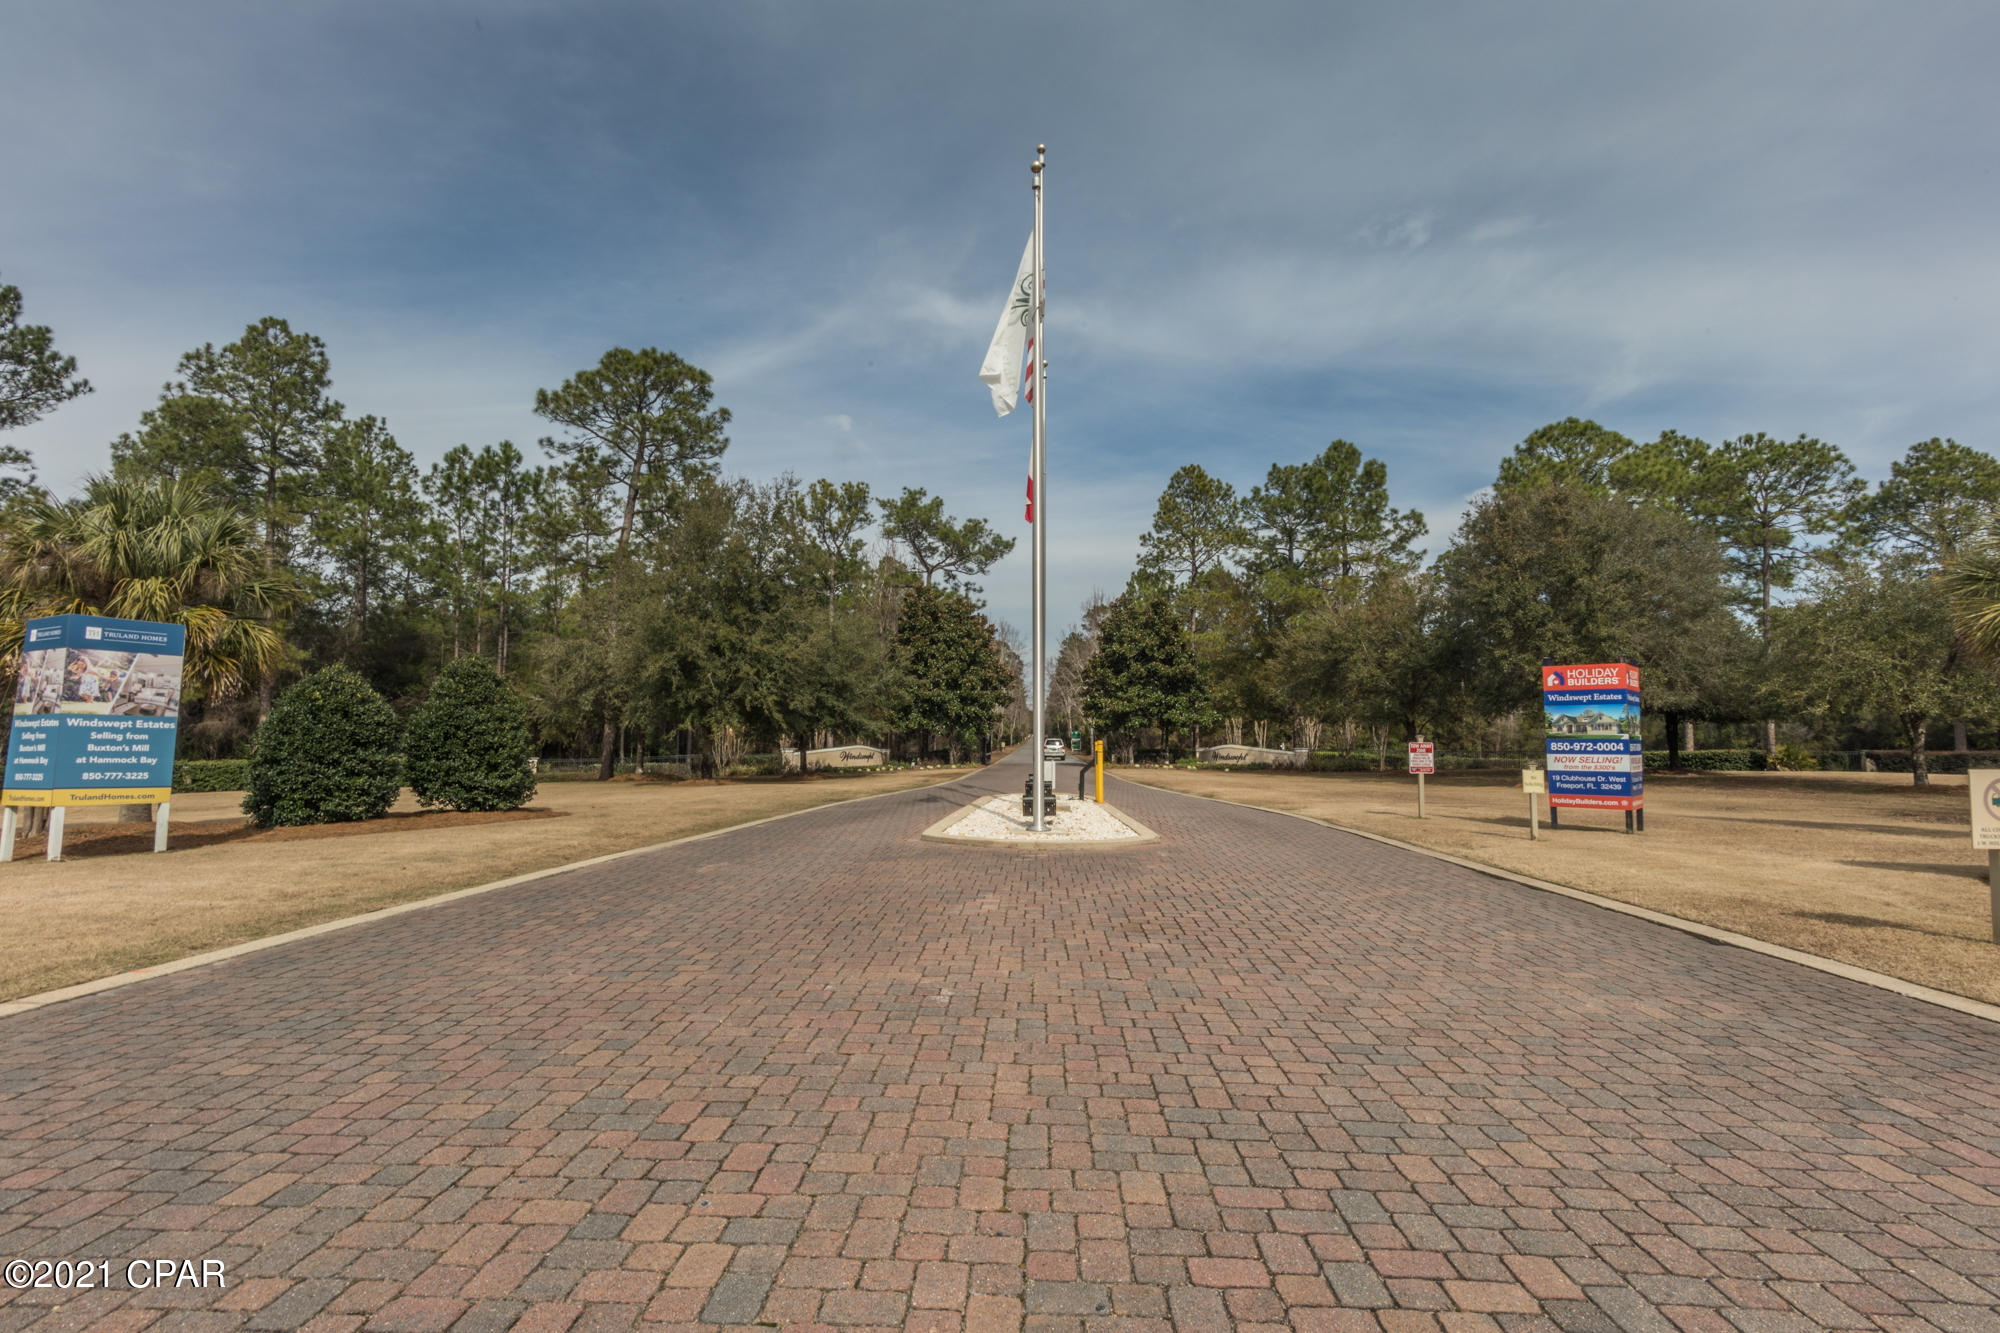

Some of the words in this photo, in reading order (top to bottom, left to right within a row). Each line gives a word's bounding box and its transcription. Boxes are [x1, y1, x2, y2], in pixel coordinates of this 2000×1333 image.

[104, 631, 139, 640] TRULAND
[141, 635, 168, 643] HOMES
[1567, 668, 1618, 678] HOLIDAY
[1567, 677, 1619, 686] BUILDERS
[1547, 693, 1592, 702] Windswept
[66, 717, 134, 730] Windswept
[135, 719, 176, 729] Estates
[90, 731, 124, 741] Selling
[125, 732, 149, 740] from
[131, 744, 150, 752] Mill
[1550, 742, 1624, 751] 850-972-0004
[89, 756, 138, 764] Hammock
[140, 757, 157, 766] Bay
[1553, 756, 1577, 764] NOW
[82, 772, 149, 780] 850-777-3225
[70, 793, 155, 801] TrulandHomes.com
[1552, 797, 1619, 806] HolidayBuilders.com
